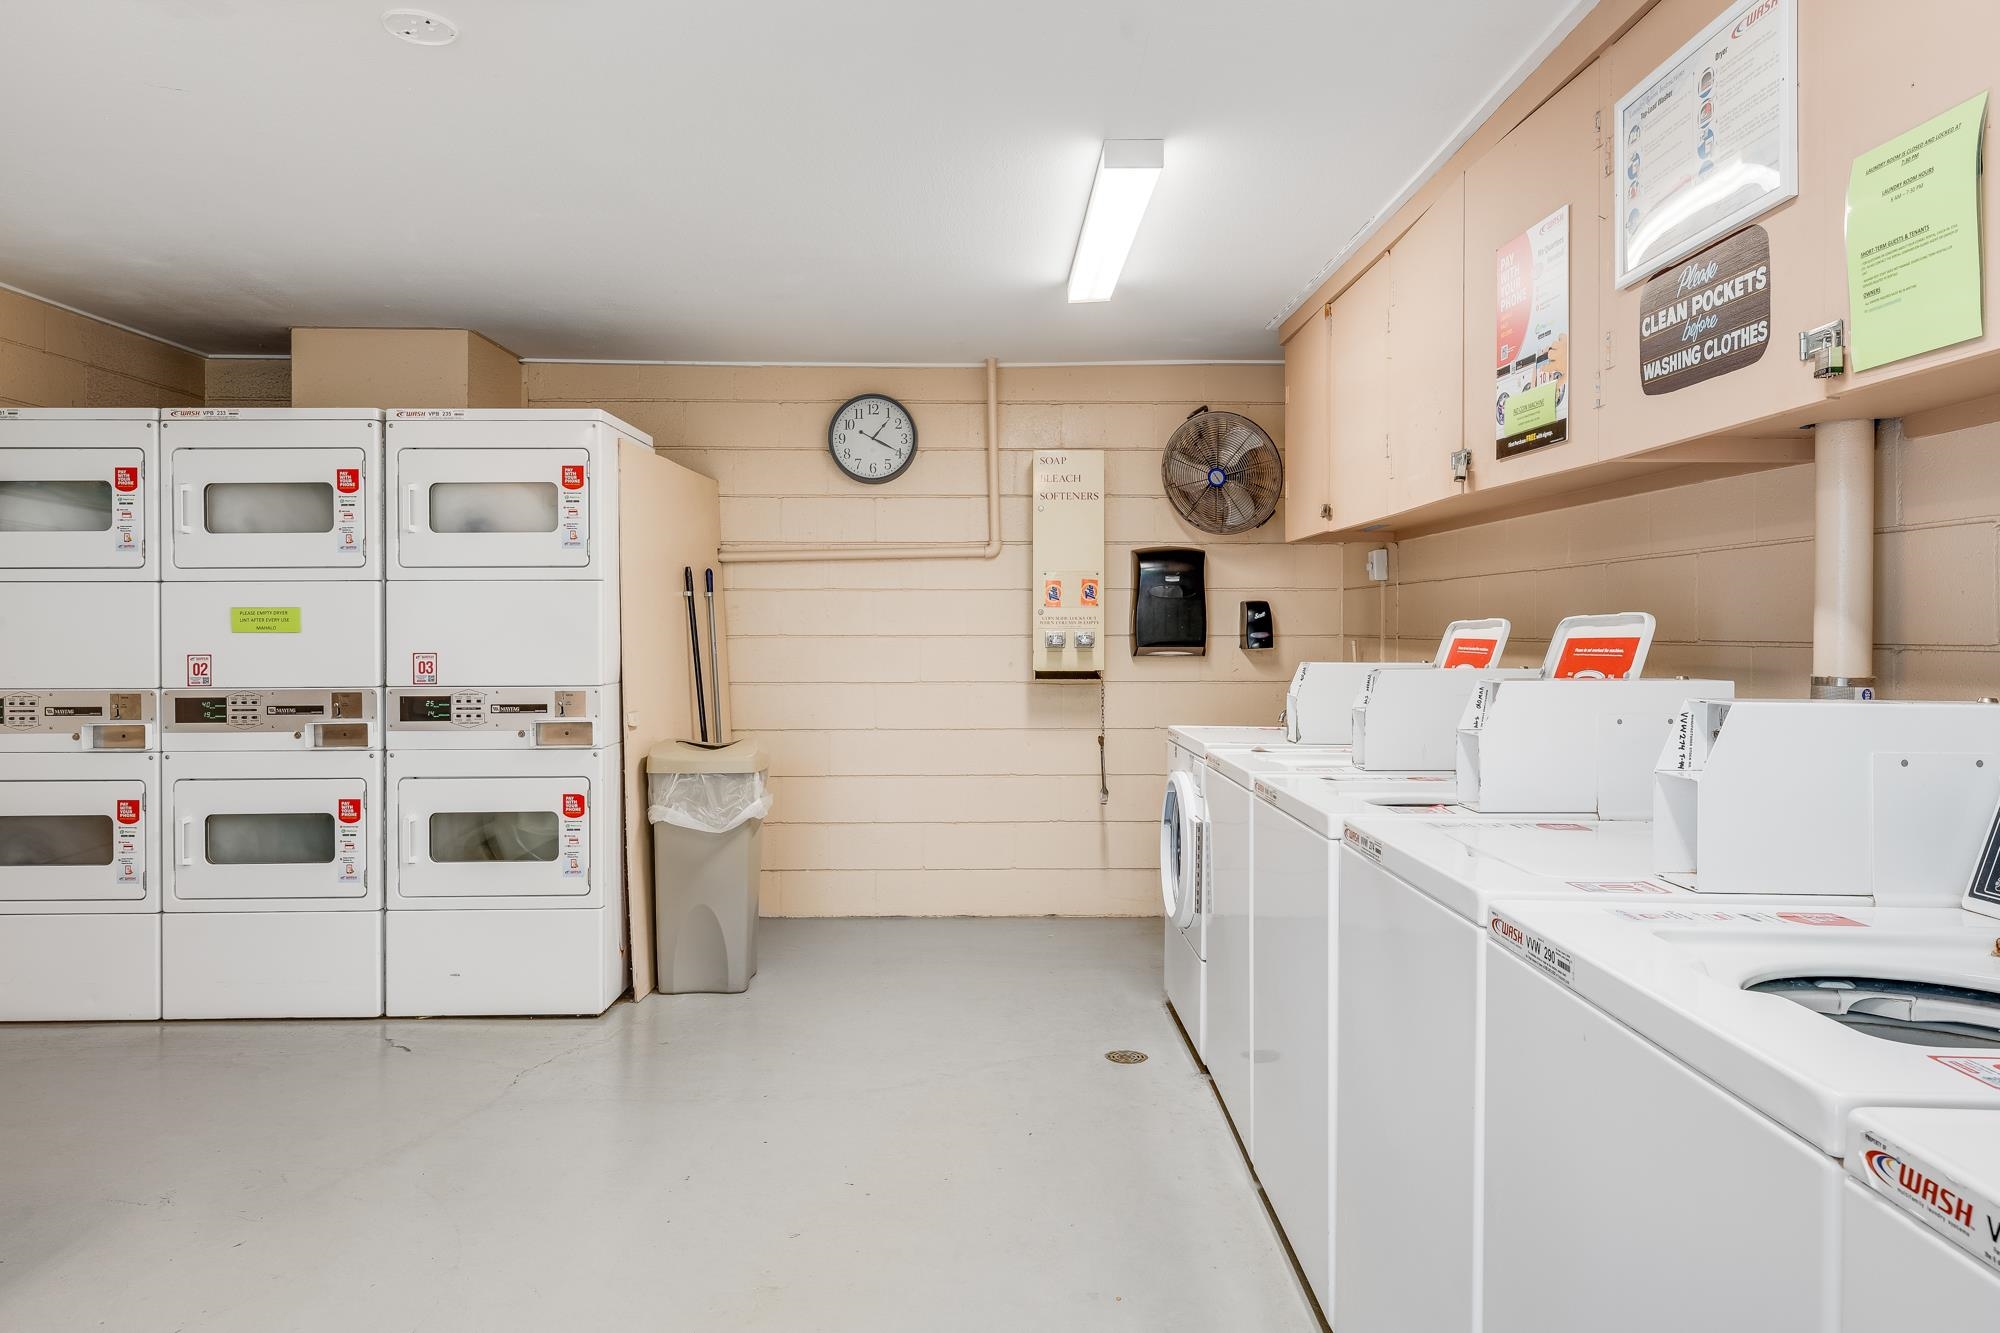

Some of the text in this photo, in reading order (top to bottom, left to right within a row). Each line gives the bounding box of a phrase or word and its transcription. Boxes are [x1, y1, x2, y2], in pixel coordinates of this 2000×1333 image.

[1715, 47, 1729, 61] Dryer
[1866, 161, 1886, 176] LAUNDRY
[1887, 154, 1901, 166] ROOM
[1906, 143, 1924, 157] CLOSED
[1924, 138, 1935, 148] AND
[1936, 127, 1955, 143] LOCKED
[1910, 153, 1920, 162] PM
[1882, 167, 1935, 198] LAUNDRY ROOM HOURS
[1861, 243, 1887, 259] SHORT-TERM
[1888, 236, 1904, 249] GUESTS
[1909, 225, 1930, 239] TENANTS
[1501, 252, 1514, 265] PAY
[1501, 264, 1520, 283] WITH
[1677, 260, 1719, 298] Please
[1501, 277, 1521, 296] YOUR
[1501, 288, 1527, 313] PHONE
[1864, 288, 1881, 300] OWNERS
[1642, 266, 1767, 337] CLEAN POCKETS
[1682, 314, 1718, 342] before
[1644, 320, 1768, 381] WASHING CLOTHES
[854, 409, 864, 419] 11
[868, 404, 880, 415] 12
[887, 408, 890, 418] 1
[844, 419, 855, 430] 10
[895, 418, 902, 429] 2
[839, 433, 846, 444] 9
[901, 433, 908, 444] 3
[844, 448, 851, 459] 8
[895, 448, 904, 459] 4
[855, 459, 862, 470] 7
[885, 459, 891, 470] 5
[1040, 457, 1067, 465] SOAP
[870, 463, 877, 474] 6
[1040, 492, 1099, 500] SOFTENERS
[1049, 587, 1060, 600] Tide
[1085, 585, 1095, 599] Tide
[193, 663, 208, 676] 02
[419, 661, 433, 674] 03
[1502, 922, 1523, 945] WASH
[1526, 935, 1541, 955] VVW
[1544, 946, 1556, 964] 290
[1865, 1134, 1881, 1149] PROPERTY
[1899, 1163, 1974, 1228] WASH
